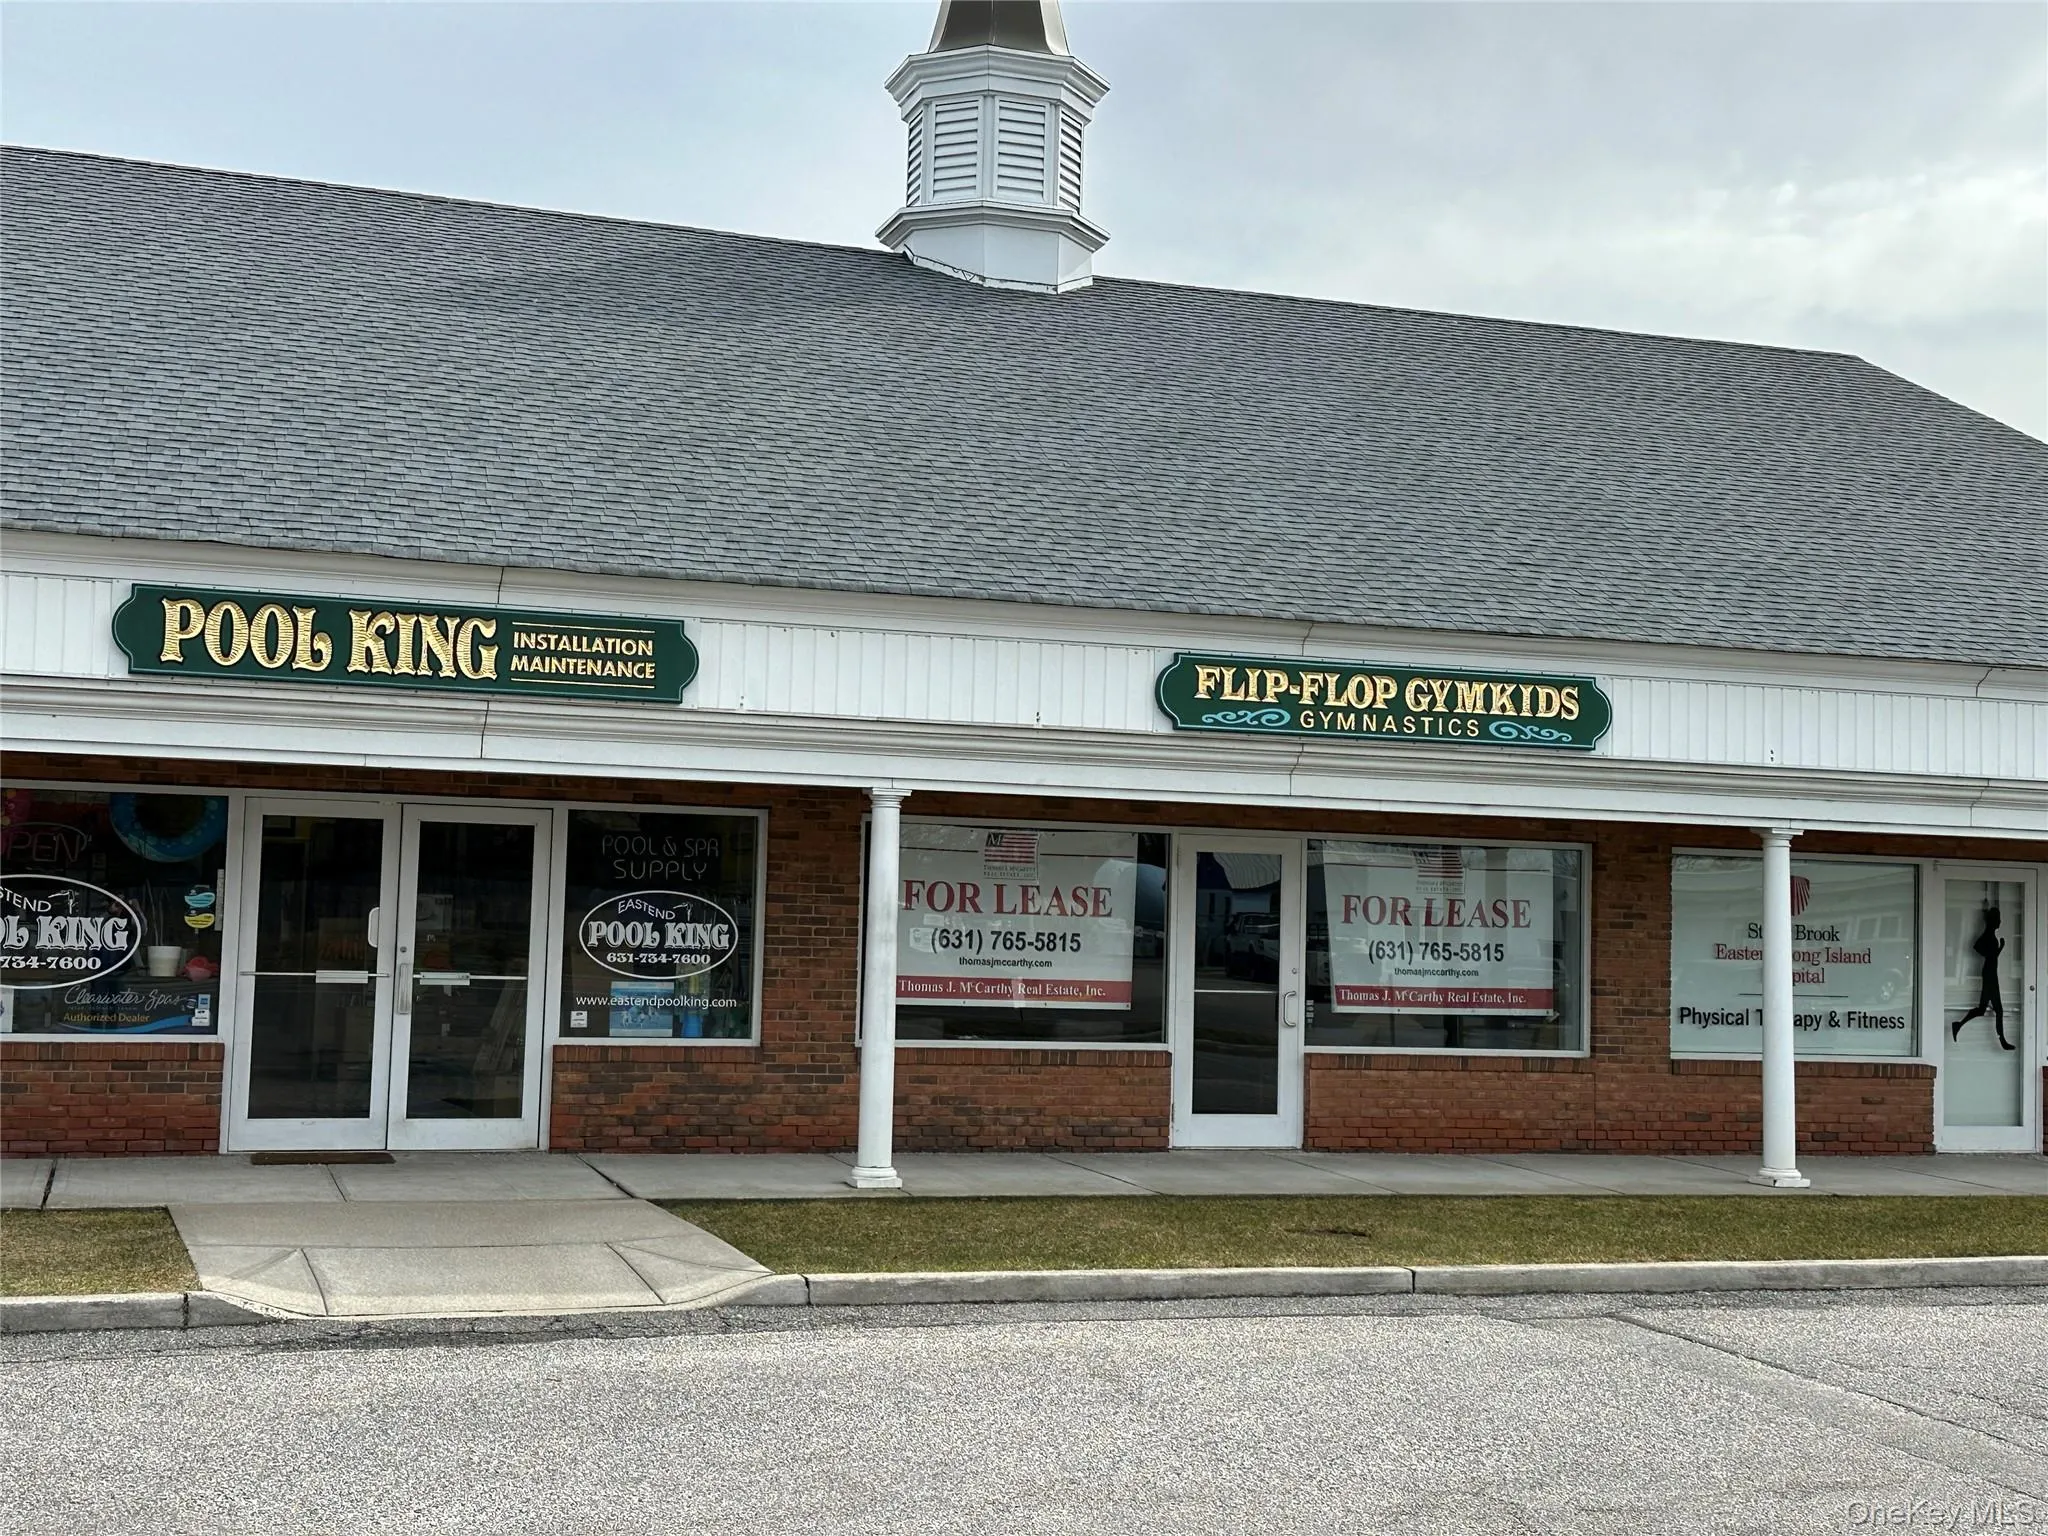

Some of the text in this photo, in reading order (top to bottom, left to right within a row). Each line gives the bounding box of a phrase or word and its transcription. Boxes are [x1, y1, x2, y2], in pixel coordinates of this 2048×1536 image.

[160, 598, 498, 681] POOL KING
[513, 632, 654, 656] INSTALLATION
[510, 655, 656, 679] MAINTENANCE
[1194, 664, 1580, 720] FLIP-FLOP GYMKIDS
[1300, 710, 1480, 737] GYMNASTICS
[602, 836, 719, 858] POOL & SPA
[613, 859, 707, 881] SUPPLY
[618, 899, 676, 920] EASTEND
[902, 879, 1113, 918] FOR LEASE
[1341, 894, 1532, 929] FOR LEASE
[36, 915, 129, 951] KING
[587, 921, 730, 950] POOL KING
[931, 927, 1082, 955] (631) 765-5815
[1794, 923, 1841, 942] Brook
[606, 952, 711, 965] 631-734-7600
[959, 956, 1053, 969] thomasjmccarthy.com
[1368, 940, 1505, 965] (631) 765-5815
[1715, 943, 1872, 966] Easter ong Island
[64, 984, 146, 1005] Clearwater
[899, 979, 943, 993] Thomas
[946, 980, 957, 993] J.
[1017, 983, 1042, 995] Real
[1046, 984, 1083, 997] Estate,
[1085, 984, 1106, 997] Inc.
[1340, 989, 1380, 1001] Thomas
[1382, 990, 1392, 1002] J.
[1447, 990, 1470, 1003] Real
[1472, 991, 1506, 1006] Estate,
[1508, 991, 1527, 1004] Inc.
[576, 995, 737, 1009] www.eastendpoolking.com
[64, 1013, 150, 1023] Authorized Dealer
[1679, 1006, 1905, 1031] Physical Tapy & Fitness
